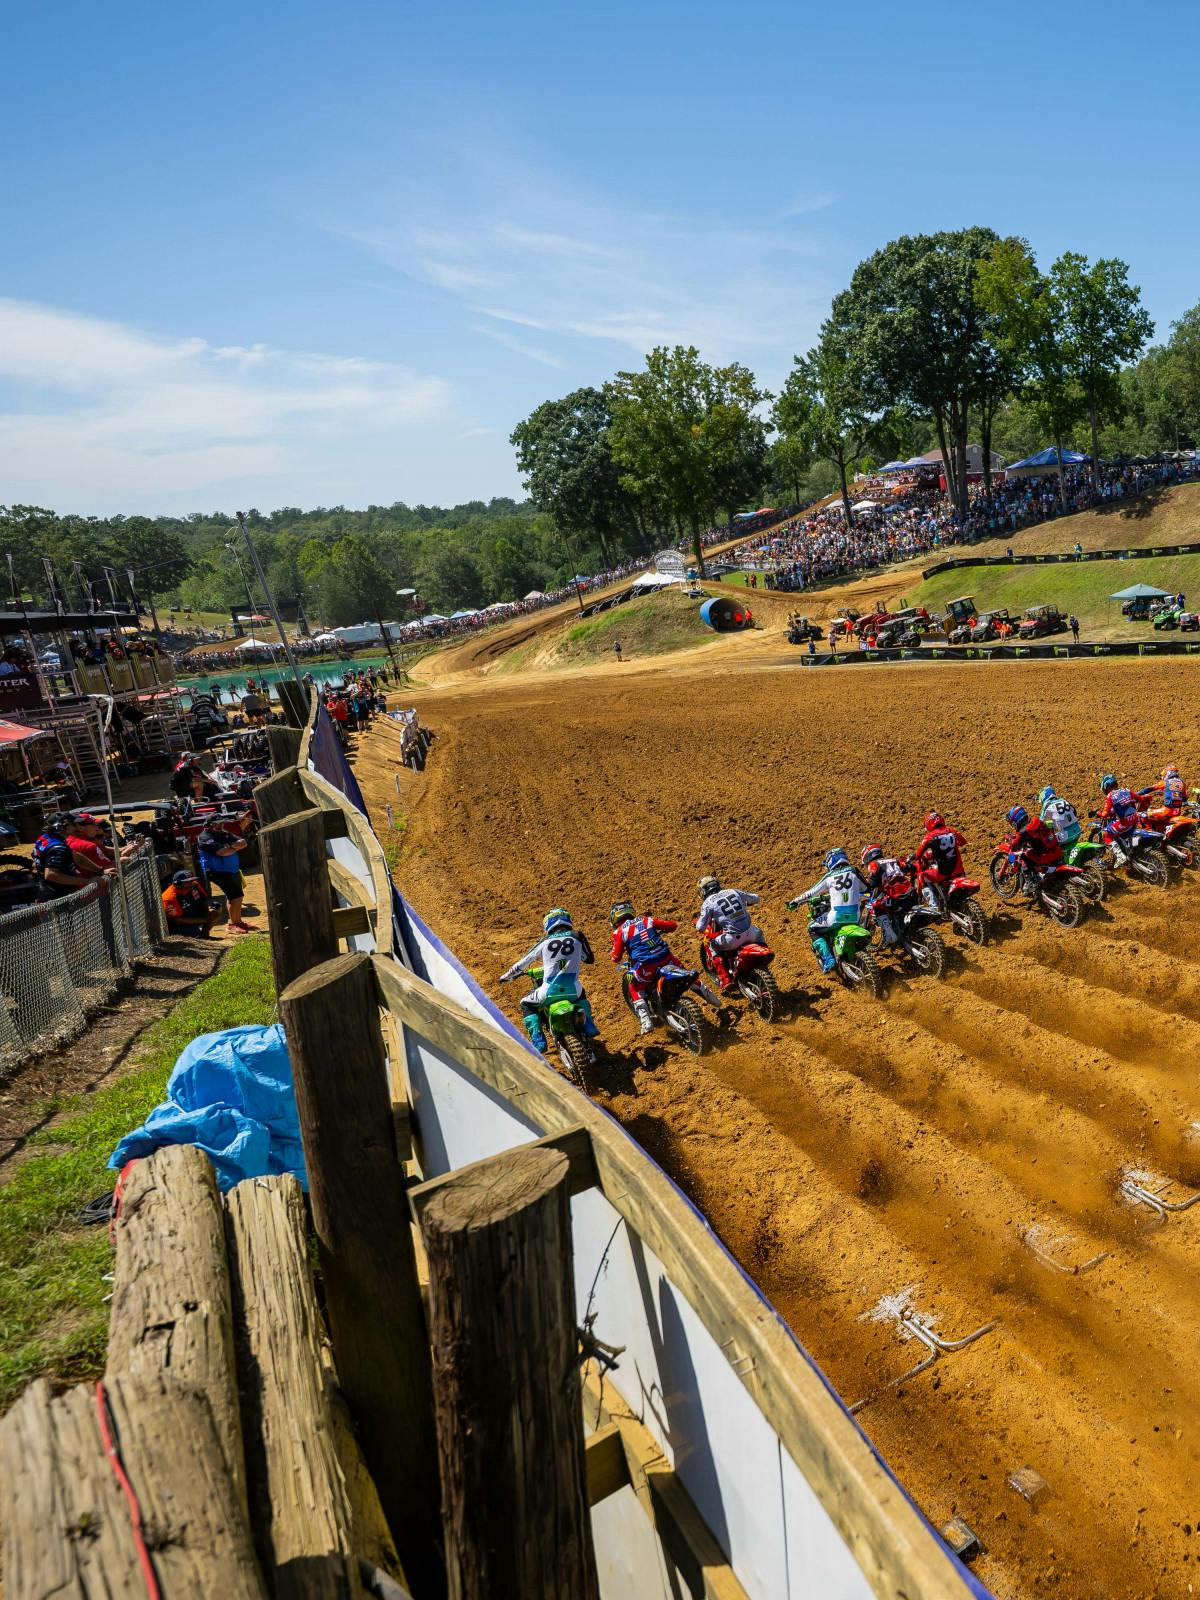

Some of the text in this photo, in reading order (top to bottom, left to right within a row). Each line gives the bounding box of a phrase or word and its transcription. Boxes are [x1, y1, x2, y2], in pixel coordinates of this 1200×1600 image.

[0, 678, 30, 687] TER
[1055, 800, 1071, 816] 56
[834, 872, 853, 891] 36
[716, 893, 742, 917] 25
[547, 938, 575, 959] 98
